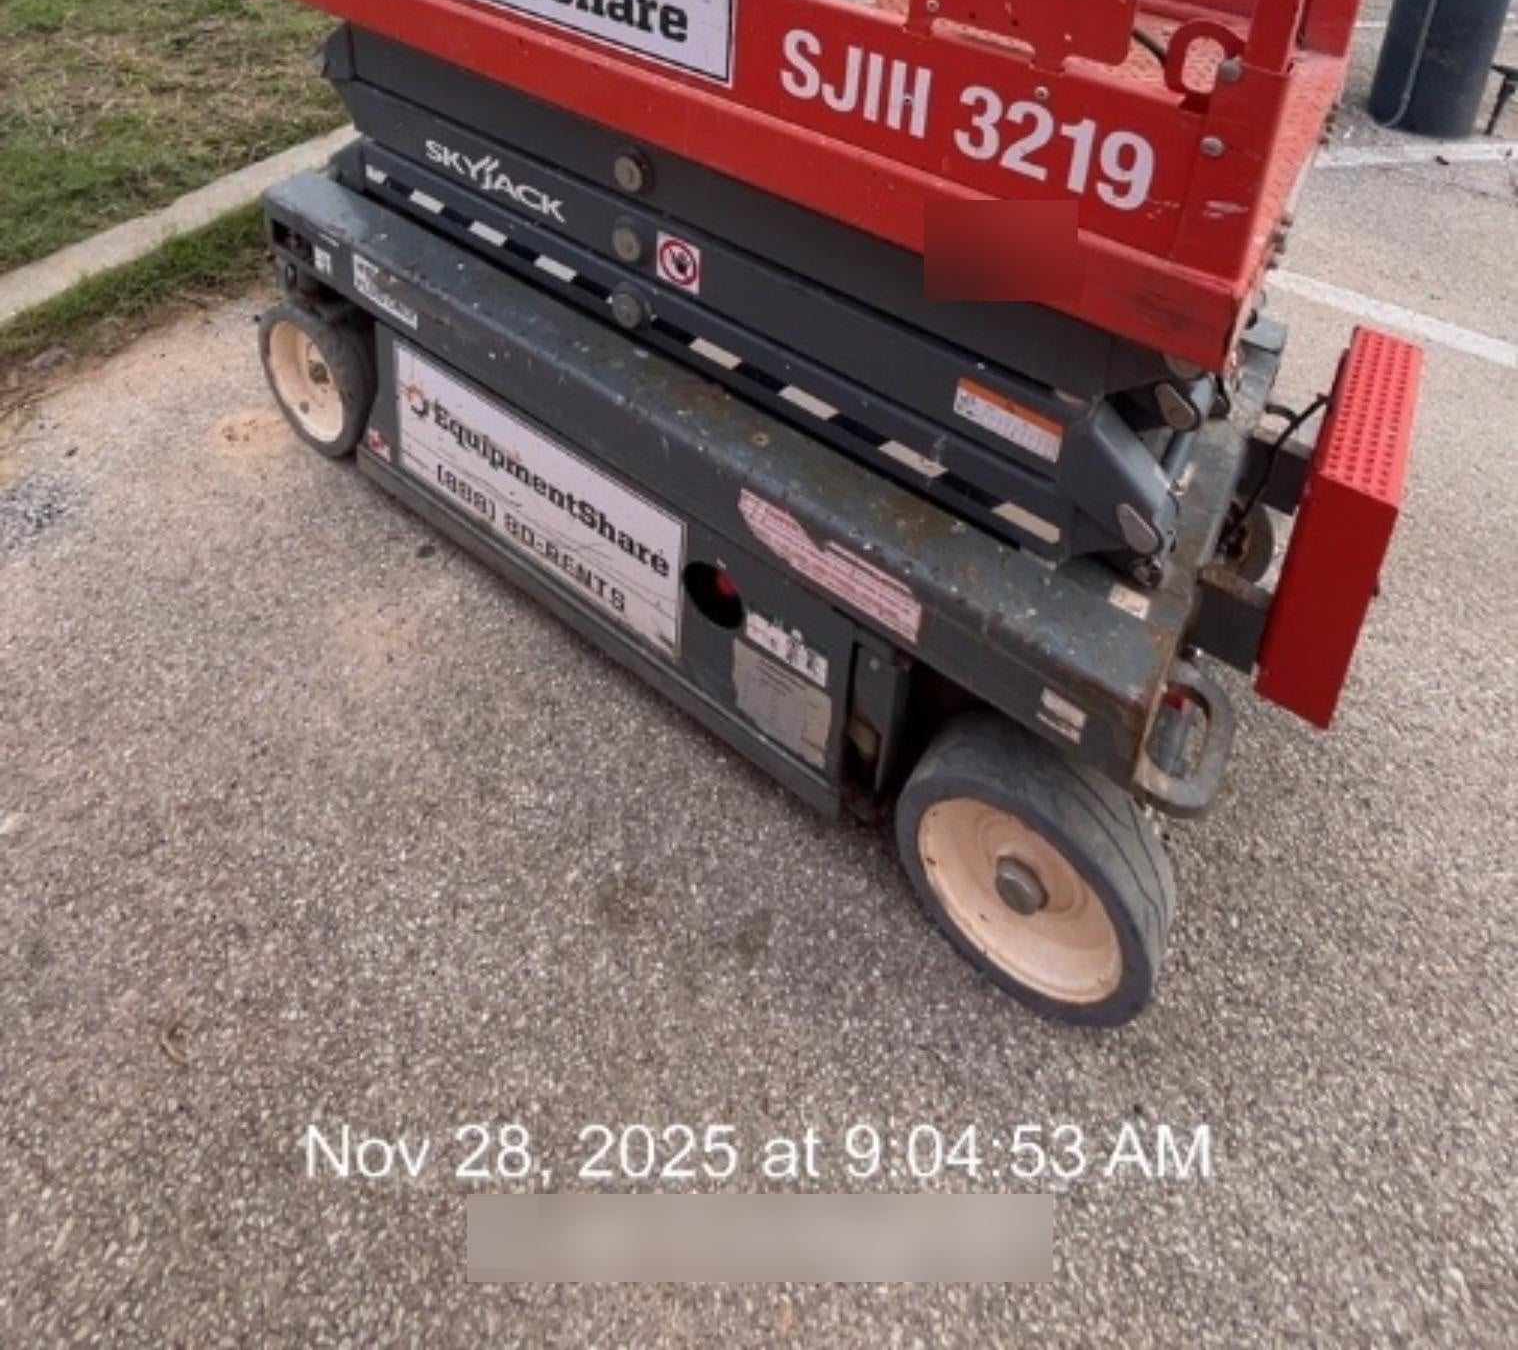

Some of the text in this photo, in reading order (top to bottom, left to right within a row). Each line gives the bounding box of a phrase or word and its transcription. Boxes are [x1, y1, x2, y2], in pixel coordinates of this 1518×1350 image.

[424, 138, 566, 224] SKYJACK
[954, 86, 1154, 211] 3219
[433, 398, 671, 578] EquipmentShare
